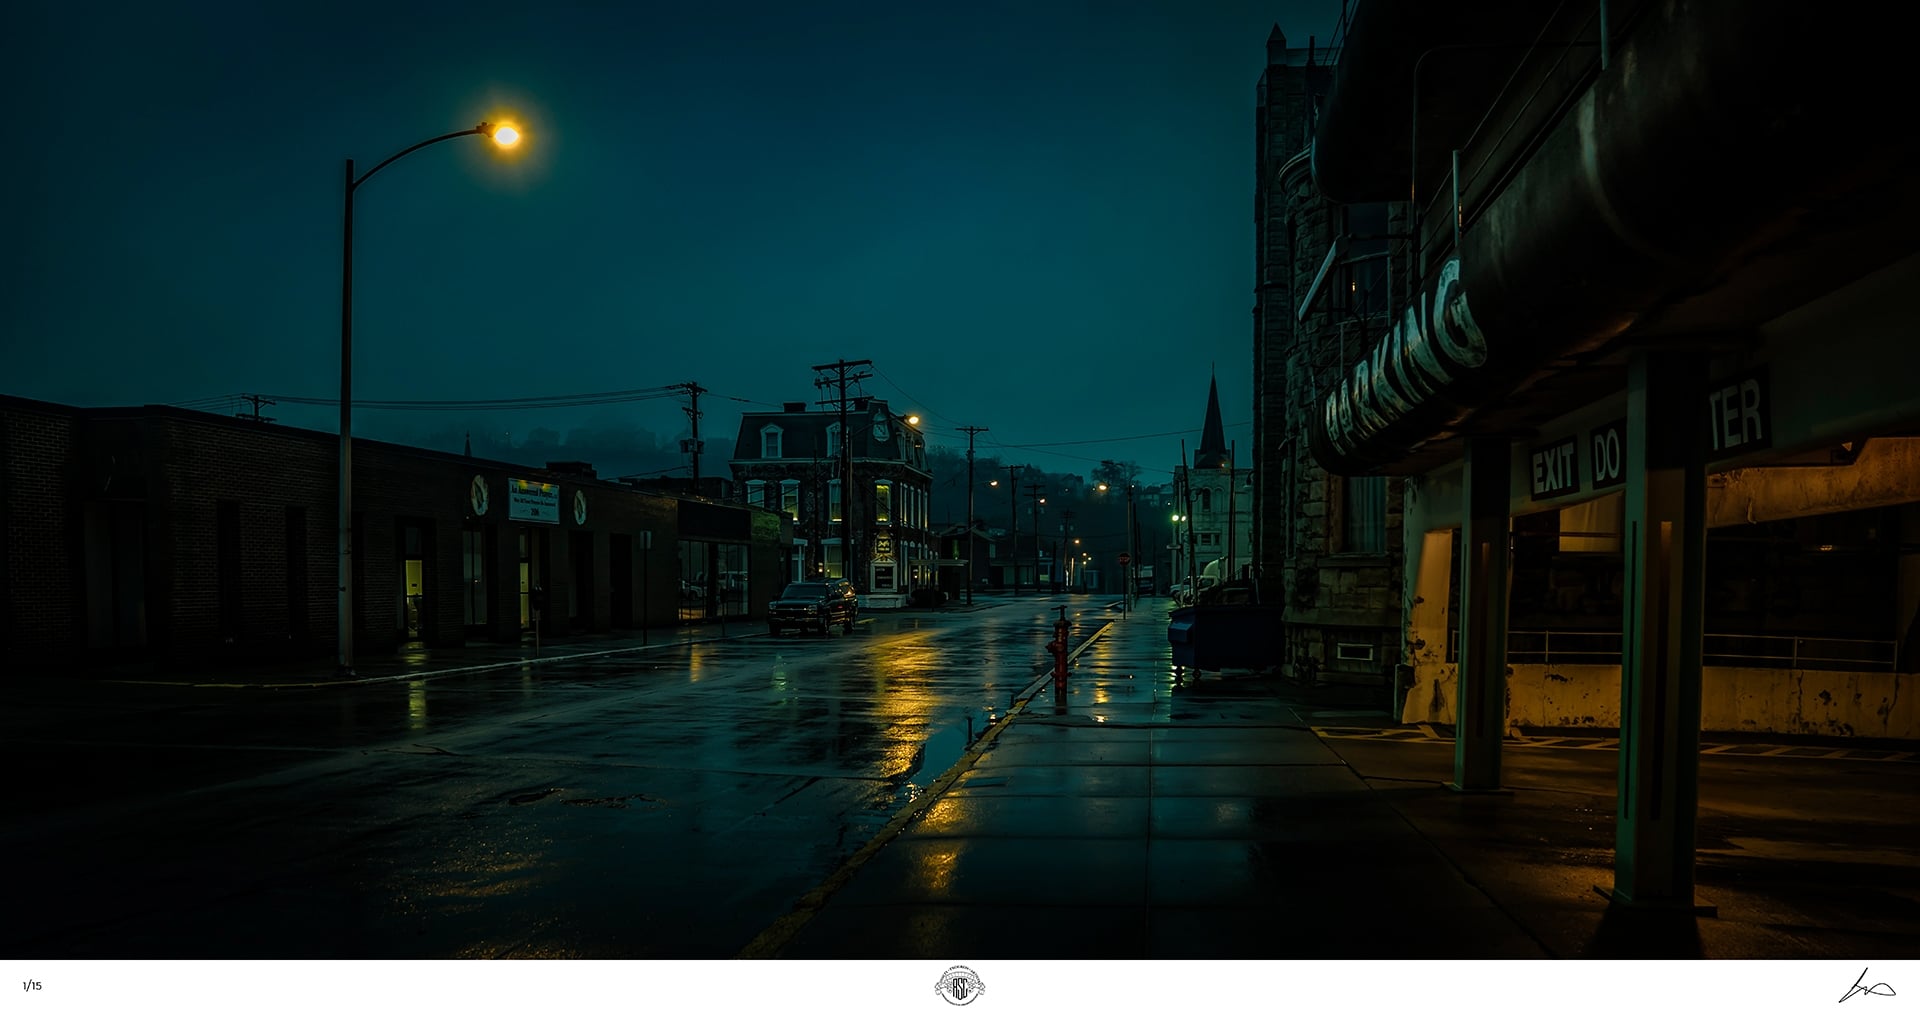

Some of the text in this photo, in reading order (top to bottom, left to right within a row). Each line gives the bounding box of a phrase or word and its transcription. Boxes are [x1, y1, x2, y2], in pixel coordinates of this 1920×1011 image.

[1325, 257, 1488, 456] PARKING
[1532, 377, 1764, 495] EXIT DO TER
